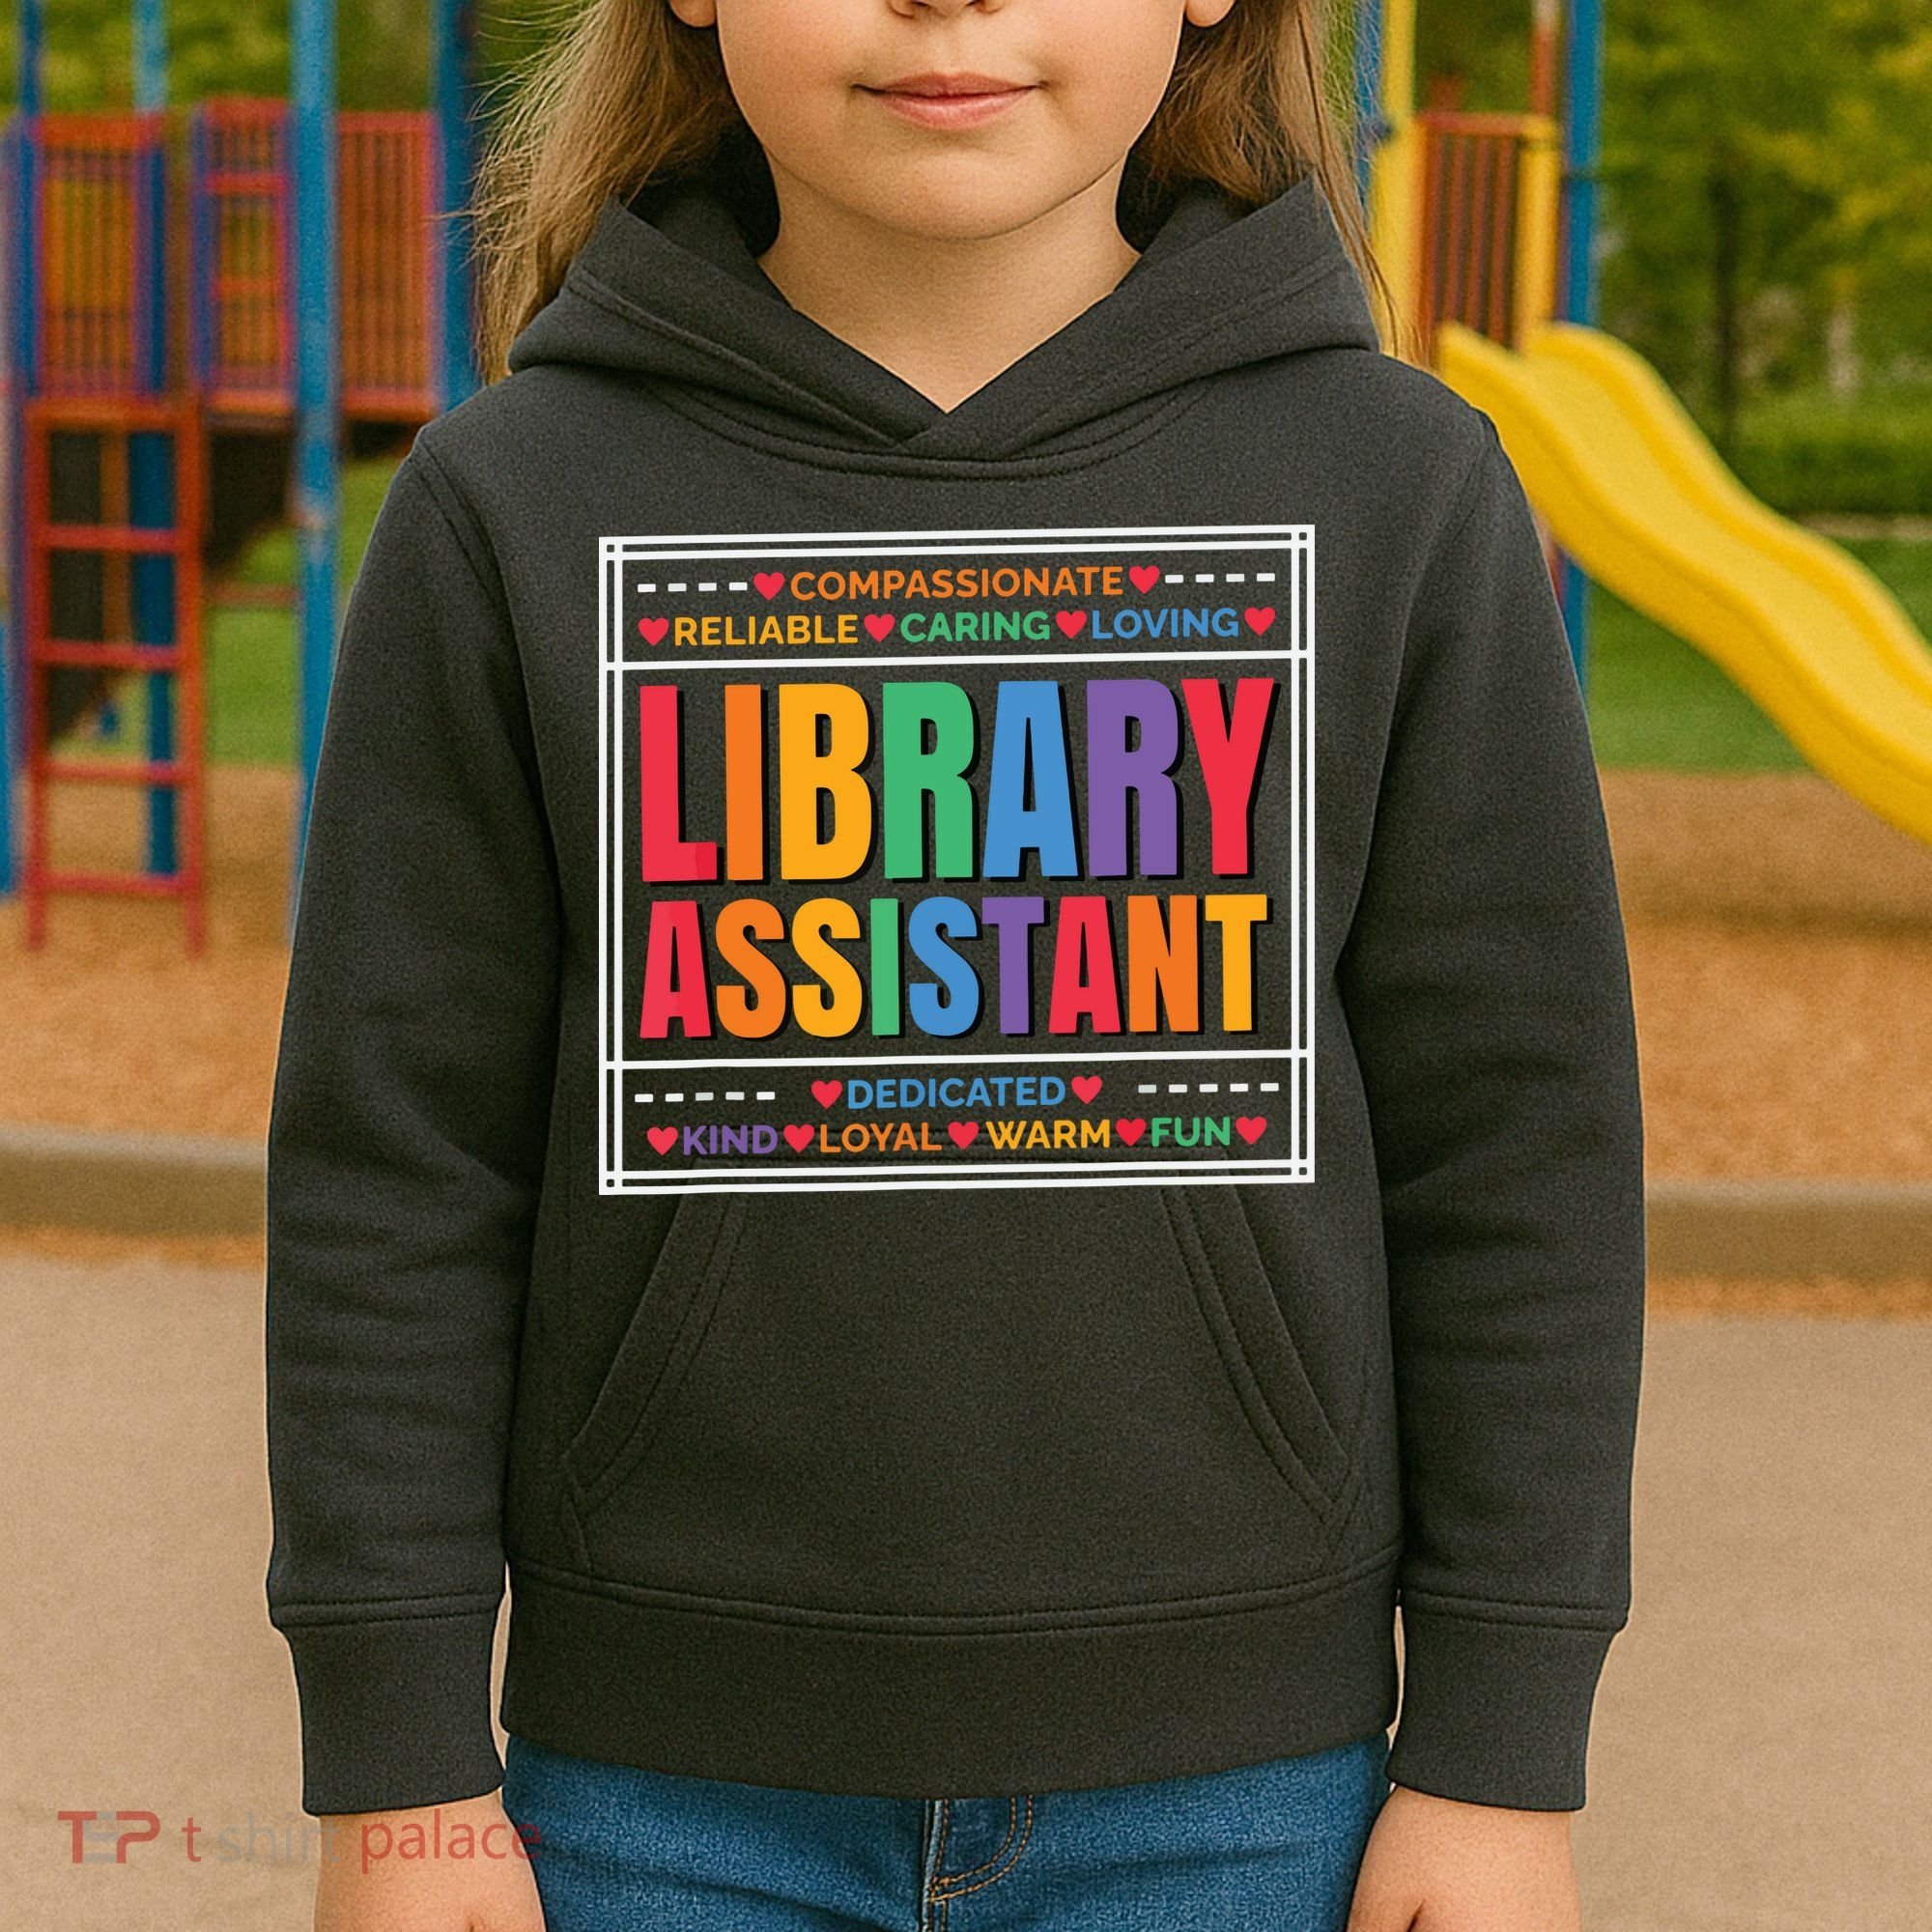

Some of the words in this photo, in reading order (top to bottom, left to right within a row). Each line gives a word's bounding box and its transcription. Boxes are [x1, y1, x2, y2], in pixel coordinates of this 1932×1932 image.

[789, 566, 1124, 602] COMPASSIONATE
[674, 613, 859, 646] RELIABLE
[899, 611, 1051, 643] CARING
[1092, 608, 1239, 639] LOVING
[639, 677, 1277, 885] LIBRARY
[639, 894, 1269, 1039] ASSISTANT
[847, 1075, 1066, 1110] DEDICATED
[682, 1123, 778, 1155] KIND
[819, 1122, 943, 1153] LOYAL
[984, 1119, 1111, 1151] WARM
[1151, 1116, 1231, 1148] FUN
